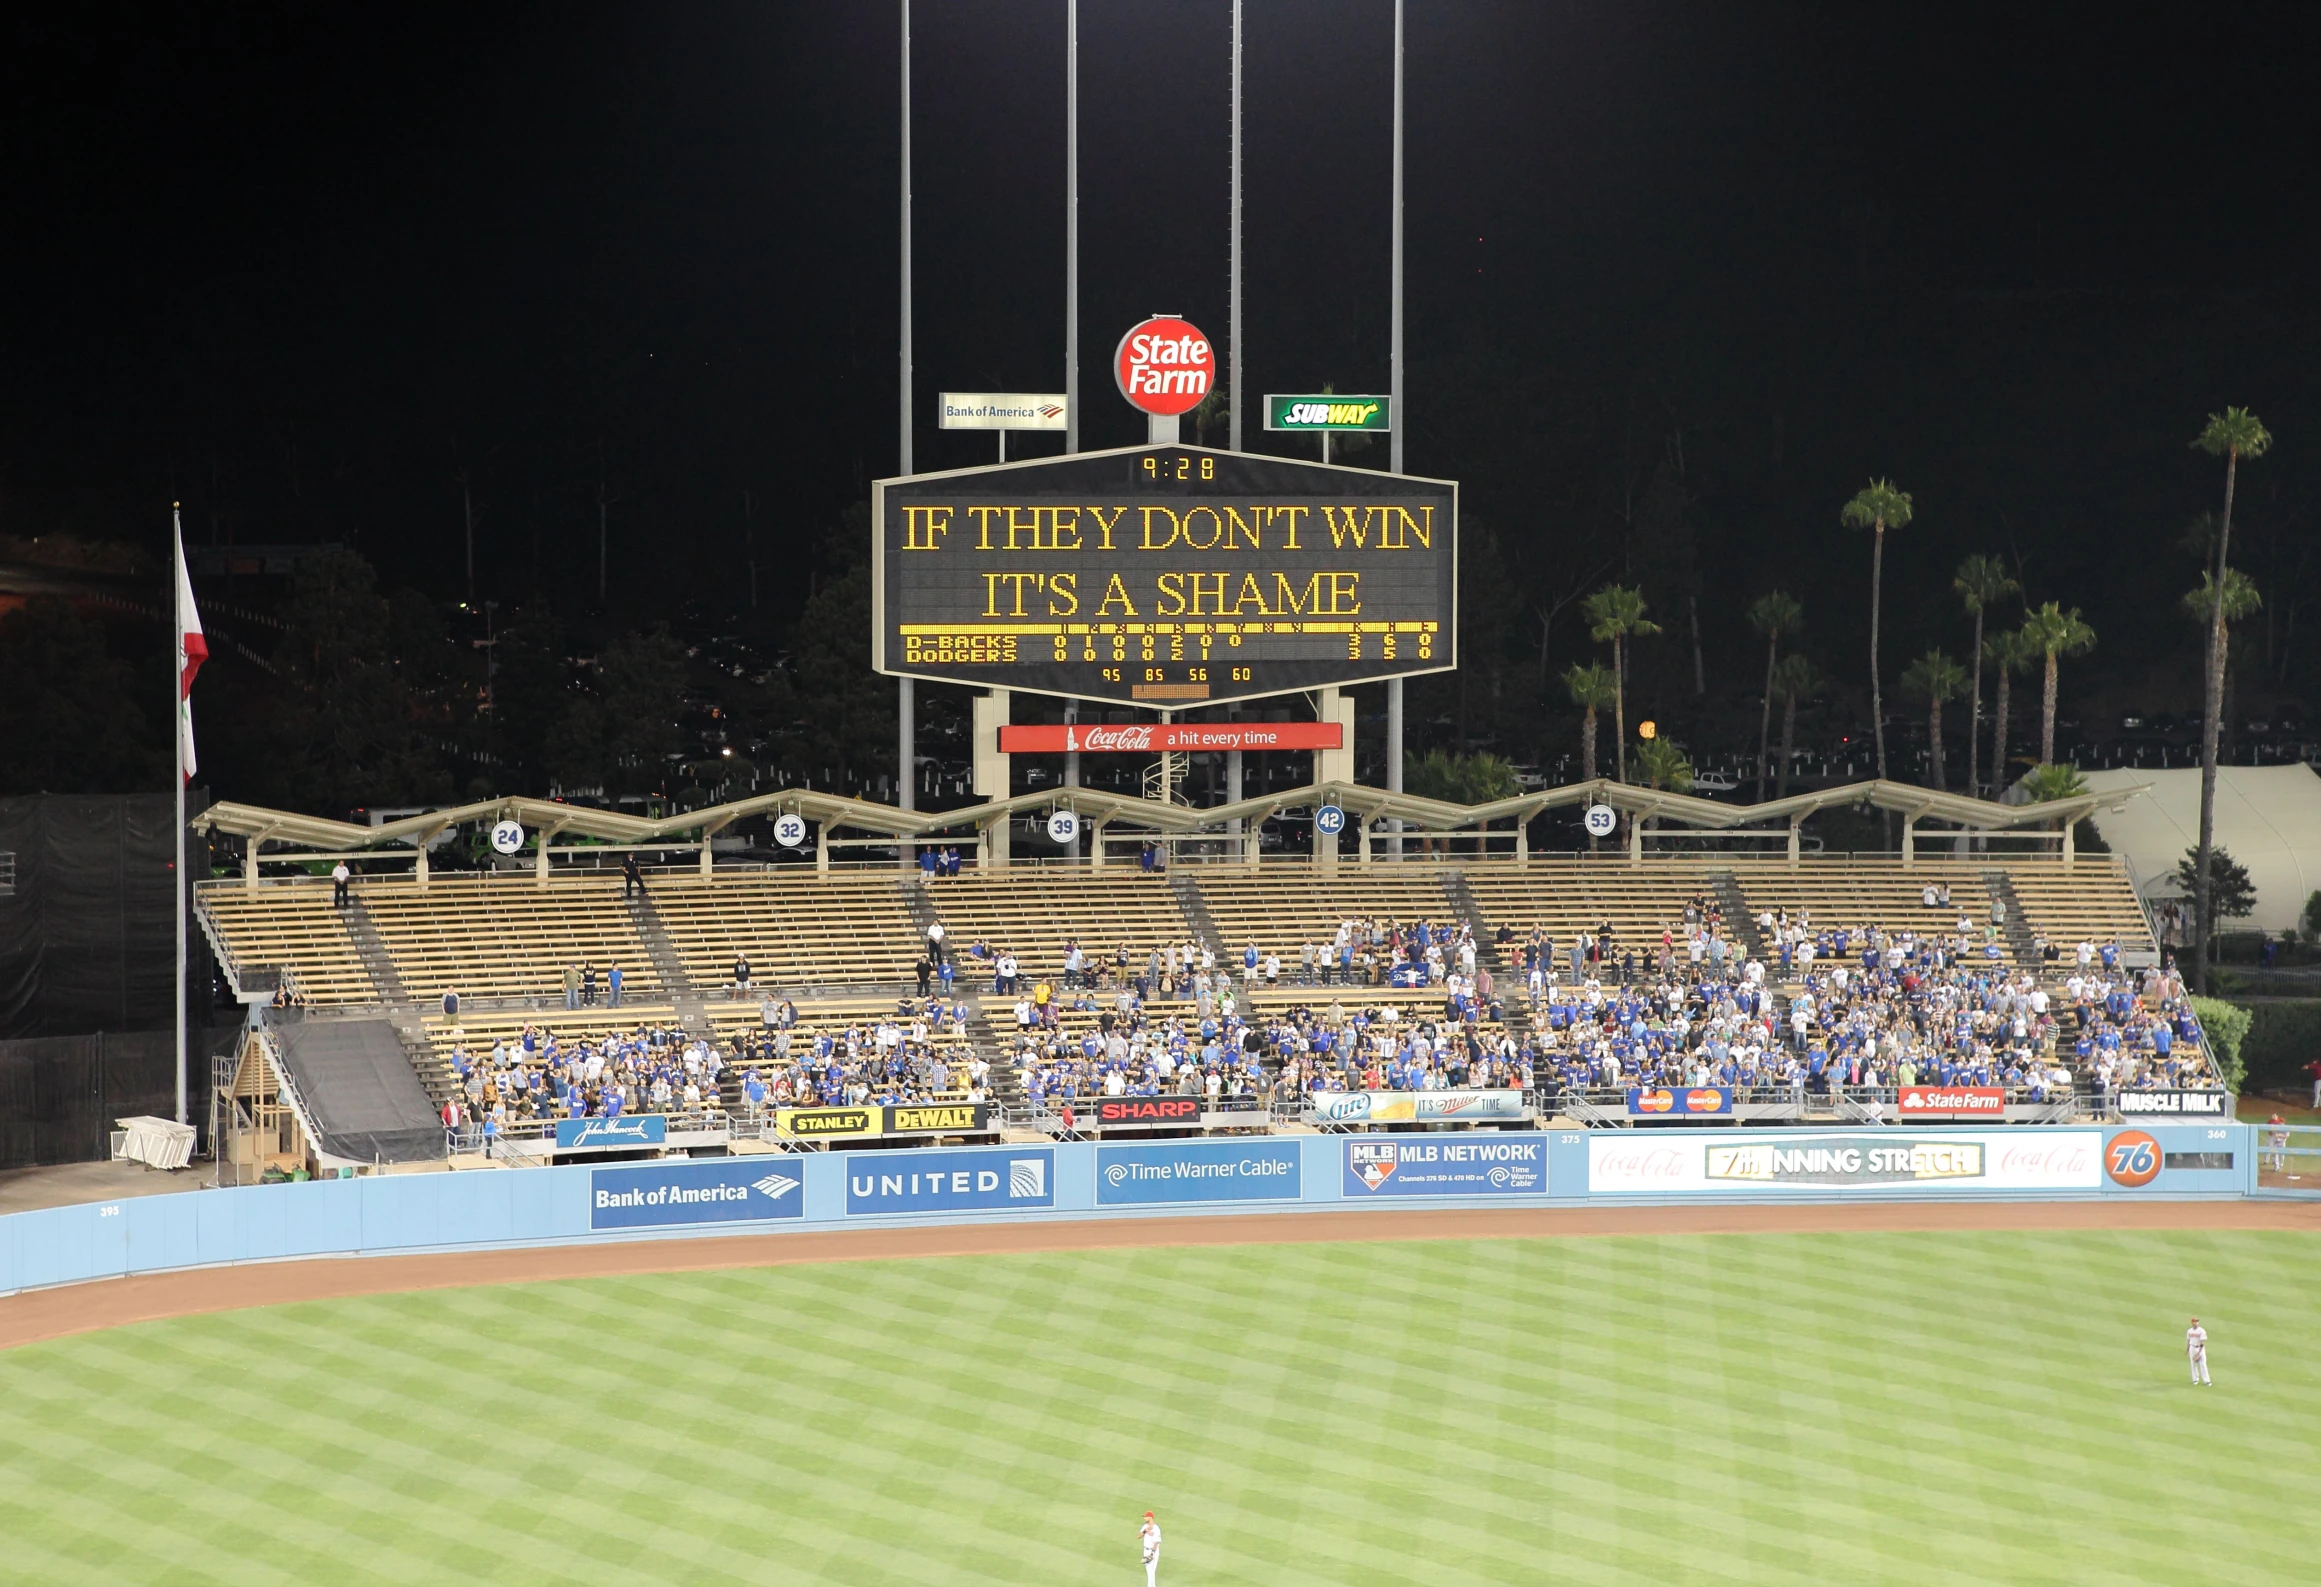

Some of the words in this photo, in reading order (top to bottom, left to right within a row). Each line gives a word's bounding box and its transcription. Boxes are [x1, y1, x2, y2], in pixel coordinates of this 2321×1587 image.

[1129, 334, 1208, 365] State
[1129, 365, 1206, 394] Farm
[946, 405, 974, 417] Bank
[975, 405, 987, 417] of
[989, 406, 1034, 417] America
[1285, 401, 1379, 425] SUBWAY
[1143, 458, 1214, 480] 9:28
[902, 506, 954, 550] IF
[968, 506, 1128, 550] THEY
[1138, 506, 1309, 550] DON'T
[1320, 506, 1435, 549] WIN
[981, 573, 1078, 617] IT'S
[1095, 573, 1139, 616] A
[1156, 572, 1362, 616] SHAME
[907, 635, 1017, 649] D-BACKS
[1055, 636, 1066, 647] 0
[1086, 636, 1091, 647] 1
[1113, 635, 1125, 647] 0
[1142, 635, 1154, 647] 0
[1171, 635, 1183, 647] 2
[1200, 634, 1212, 646] 0
[1229, 635, 1241, 646] 0
[1349, 634, 1361, 645] 3
[1384, 634, 1396, 645] 6
[1419, 633, 1431, 645] 0
[907, 649, 1017, 662] DODGERS
[1055, 649, 1066, 661] 0
[1084, 649, 1096, 661] 0
[1113, 649, 1125, 661] 0
[1142, 648, 1154, 660] 0
[1171, 649, 1183, 660] 2
[1203, 648, 1207, 660] 1
[1349, 647, 1360, 659] 3
[1384, 647, 1396, 659] 5
[1419, 647, 1431, 659] 0
[1102, 668, 1121, 682] 95
[1145, 668, 1164, 682] 85
[1189, 668, 1207, 681] 56
[1232, 667, 1251, 681] 60
[1085, 726, 1154, 749] Coca-Cola
[1168, 734, 1176, 745] a
[1180, 731, 1198, 744] hit
[1202, 733, 1240, 747] every
[1244, 731, 1276, 744] time
[1054, 820, 1073, 835] 39
[1319, 812, 1339, 828] 42
[1591, 813, 1610, 828] 53
[498, 829, 518, 845] 24
[780, 823, 799, 838] 32
[1338, 1097, 1366, 1119] Lite
[1418, 1099, 1434, 1112] IT'S
[1436, 1096, 1480, 1112] Miller
[1482, 1098, 1501, 1111] TIME
[1638, 1097, 1673, 1105] MasterCard
[1686, 1096, 1721, 1104] MasterCard
[1926, 1093, 1962, 1108] State
[1963, 1093, 1999, 1108] Farm
[2120, 1093, 2180, 1112] MUSCLE
[2182, 1093, 2221, 1112] MILK
[1101, 1101, 1196, 1119] SHARP
[796, 1115, 865, 1130] STANLEY
[573, 1121, 603, 1146] John
[604, 1119, 648, 1139] Hancock
[1561, 1135, 1580, 1144] 375
[2208, 1130, 2227, 1139] 360
[1353, 1145, 1394, 1159] MLB
[1400, 1145, 1438, 1162] MLB
[1444, 1144, 1537, 1161] NETWORK
[2112, 1141, 2156, 1175] 76
[1768, 1148, 1861, 1173] NNING
[1868, 1148, 1968, 1173] STRETCH
[1129, 1162, 1171, 1180] Time
[1174, 1161, 1236, 1178] Warner
[1239, 1159, 1287, 1176] Cable
[852, 1171, 999, 1197] UNITED
[596, 1188, 645, 1208] Bank
[647, 1186, 667, 1205] of
[668, 1183, 748, 1203] America
[100, 1206, 120, 1218] 395
